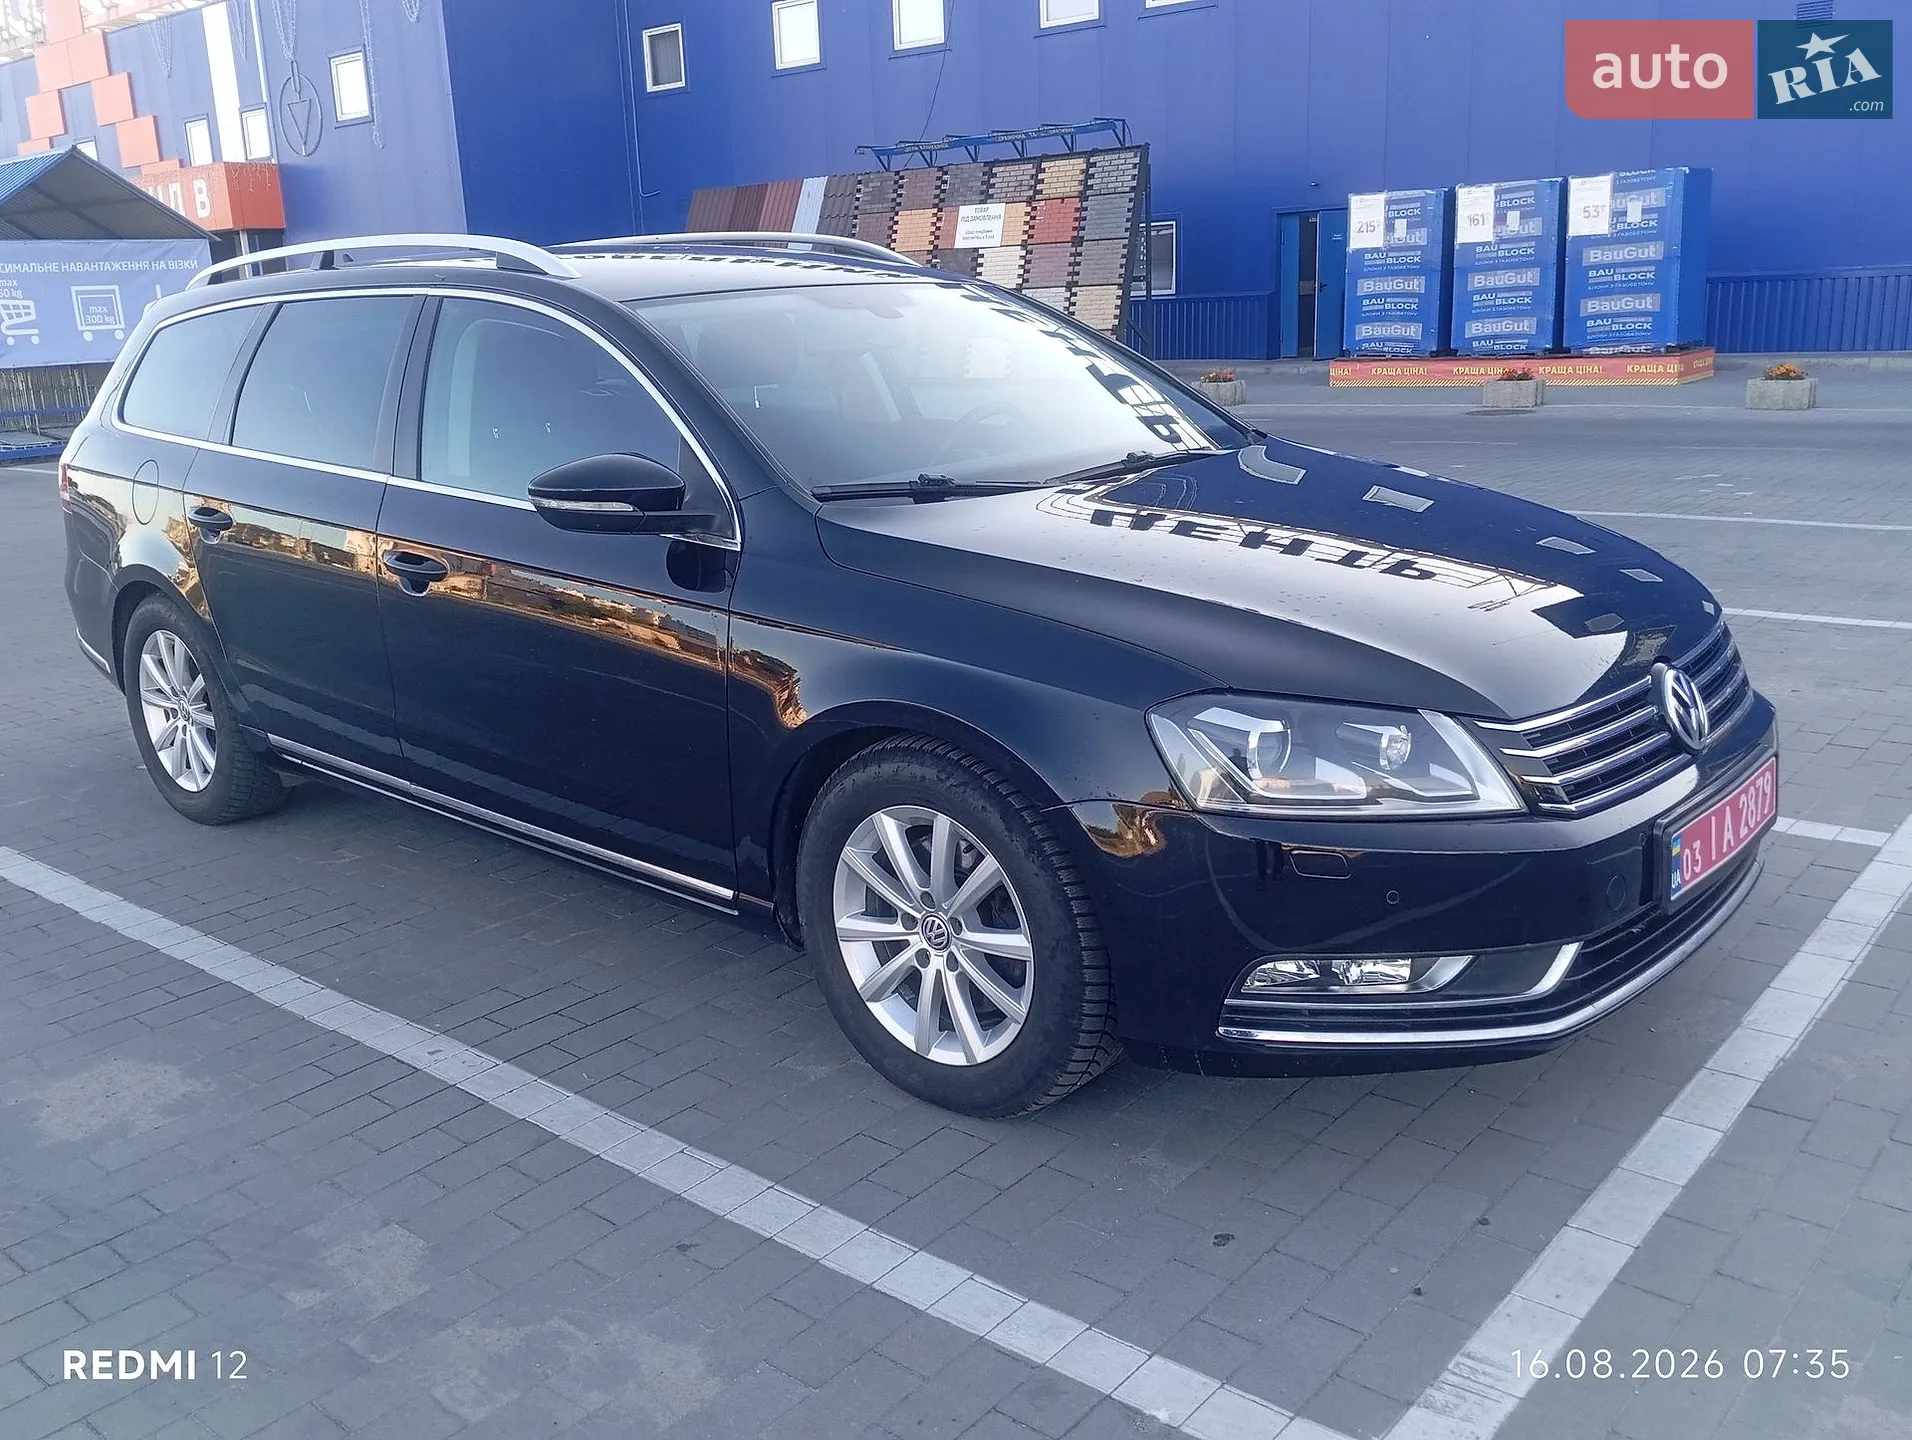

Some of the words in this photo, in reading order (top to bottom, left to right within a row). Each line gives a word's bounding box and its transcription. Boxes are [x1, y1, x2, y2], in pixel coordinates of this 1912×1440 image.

[1500, 197, 1535, 208] BLOCK
[1388, 208, 1421, 217] BLOCK
[1467, 213, 1486, 227] 161
[1616, 220, 1658, 231] BLOCK
[1357, 219, 1376, 234] 215
[1475, 244, 1498, 253] BAU
[1498, 247, 1535, 257] BLOCK
[1589, 245, 1657, 262] BauGut
[1364, 252, 1386, 260] BAU
[1386, 256, 1421, 264] BLOCK
[61, 260, 149, 272] НАВАНТАЖЕННЯ
[151, 260, 167, 270] НА
[168, 259, 198, 270] ВІЗКИ
[1473, 271, 1534, 288] BauGut
[1588, 268, 1614, 277] BAU
[1613, 272, 1655, 281] BLOCK
[1363, 279, 1419, 292] BauGut
[11, 288, 23, 299] kg
[1473, 293, 1496, 301] BAU
[1495, 297, 1532, 305] BLOCK
[1362, 298, 1385, 306] BAU
[1587, 297, 1653, 313] BauGut
[89, 305, 108, 313] max
[86, 315, 104, 325] 300
[104, 314, 116, 325] kg
[1586, 318, 1612, 327] BAU
[1611, 322, 1652, 331] BLOCK
[1361, 325, 1416, 337] BauGut
[1471, 320, 1529, 334] BauGut
[1472, 340, 1493, 348] BAU
[1371, 367, 1402, 376] КРАЩА
[1403, 367, 1427, 376] ЦІНА!
[1453, 366, 1485, 375] КРАЩА
[1538, 365, 1574, 375] КРАЩА
[1575, 365, 1602, 374] ЦІНА!
[1626, 364, 1664, 374] КРАЩА
[1682, 839, 1702, 881] 03
[1739, 770, 1772, 839] 2879
[1671, 869, 1681, 889] UA
